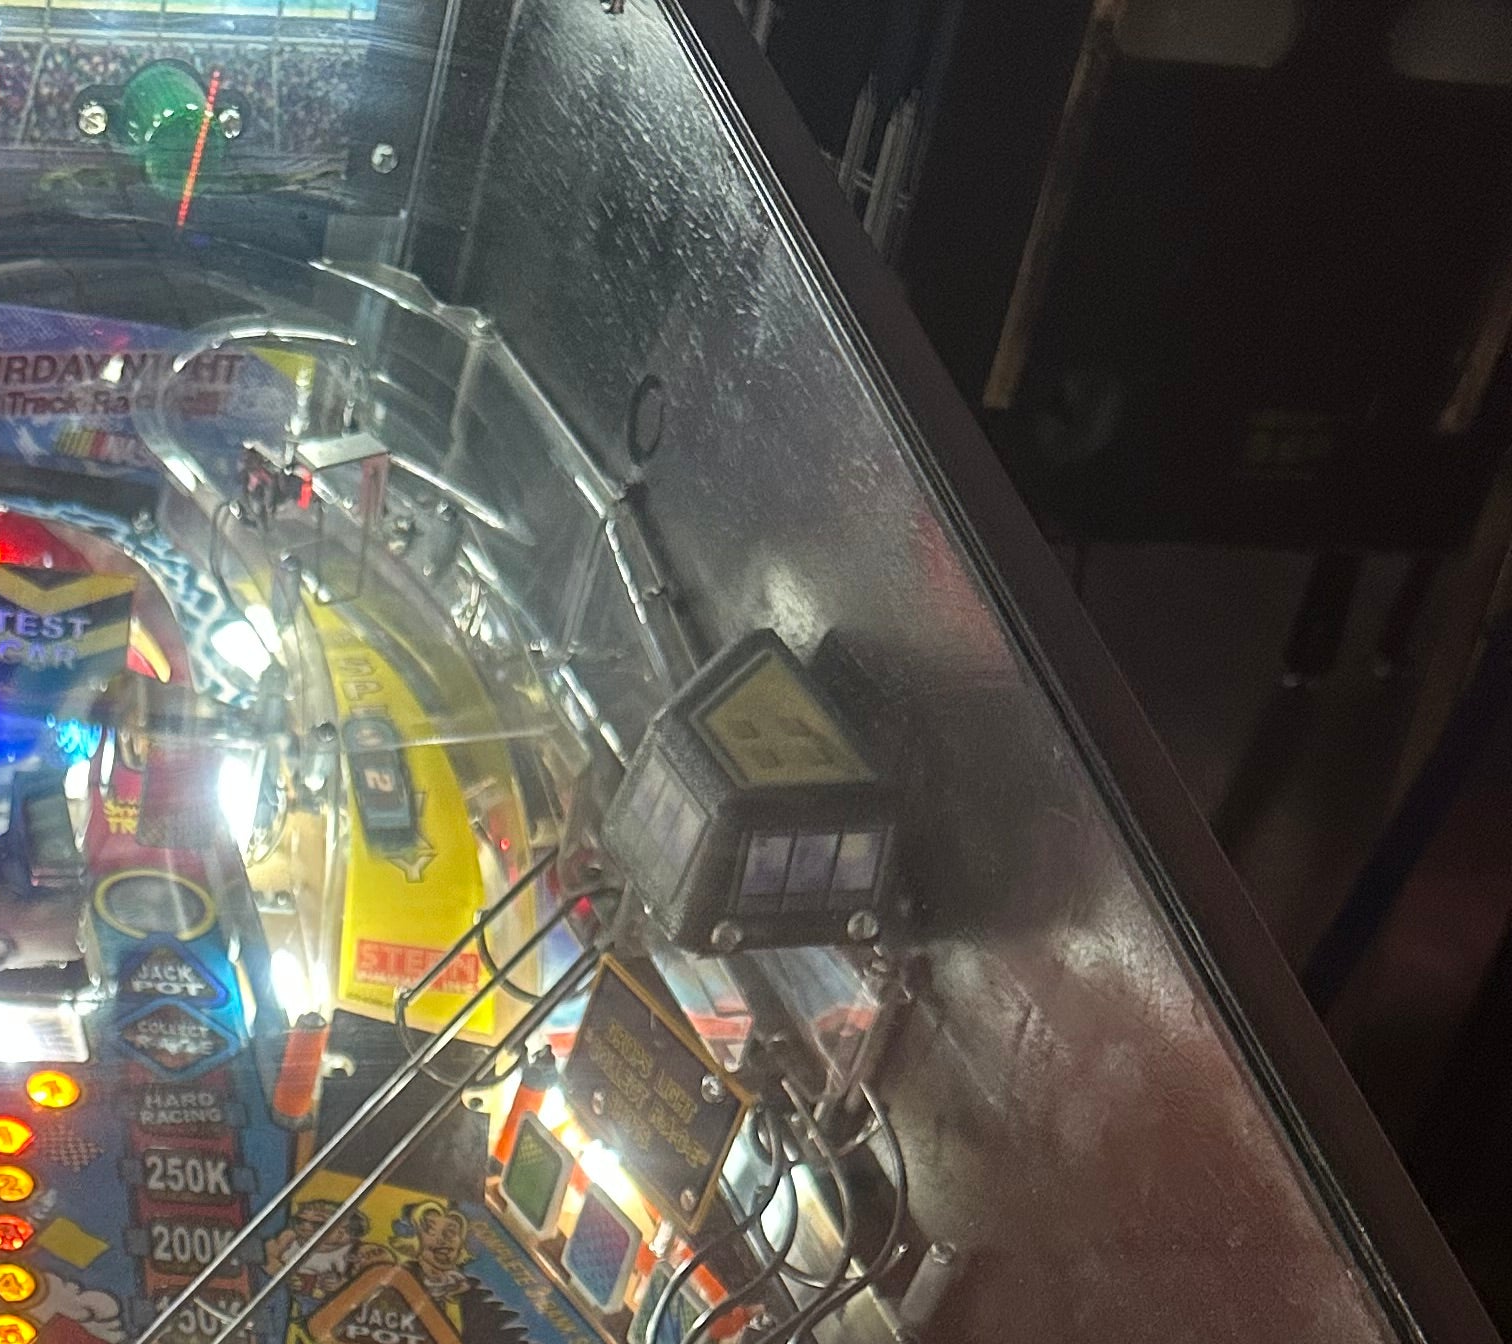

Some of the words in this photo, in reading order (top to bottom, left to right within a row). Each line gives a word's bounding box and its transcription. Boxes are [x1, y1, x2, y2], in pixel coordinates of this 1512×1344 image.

[139, 964, 194, 981] JACK
[131, 979, 205, 997] POT
[140, 1109, 222, 1125] RACING
[145, 1155, 232, 1195] 250K
[356, 1304, 415, 1331] JACK
